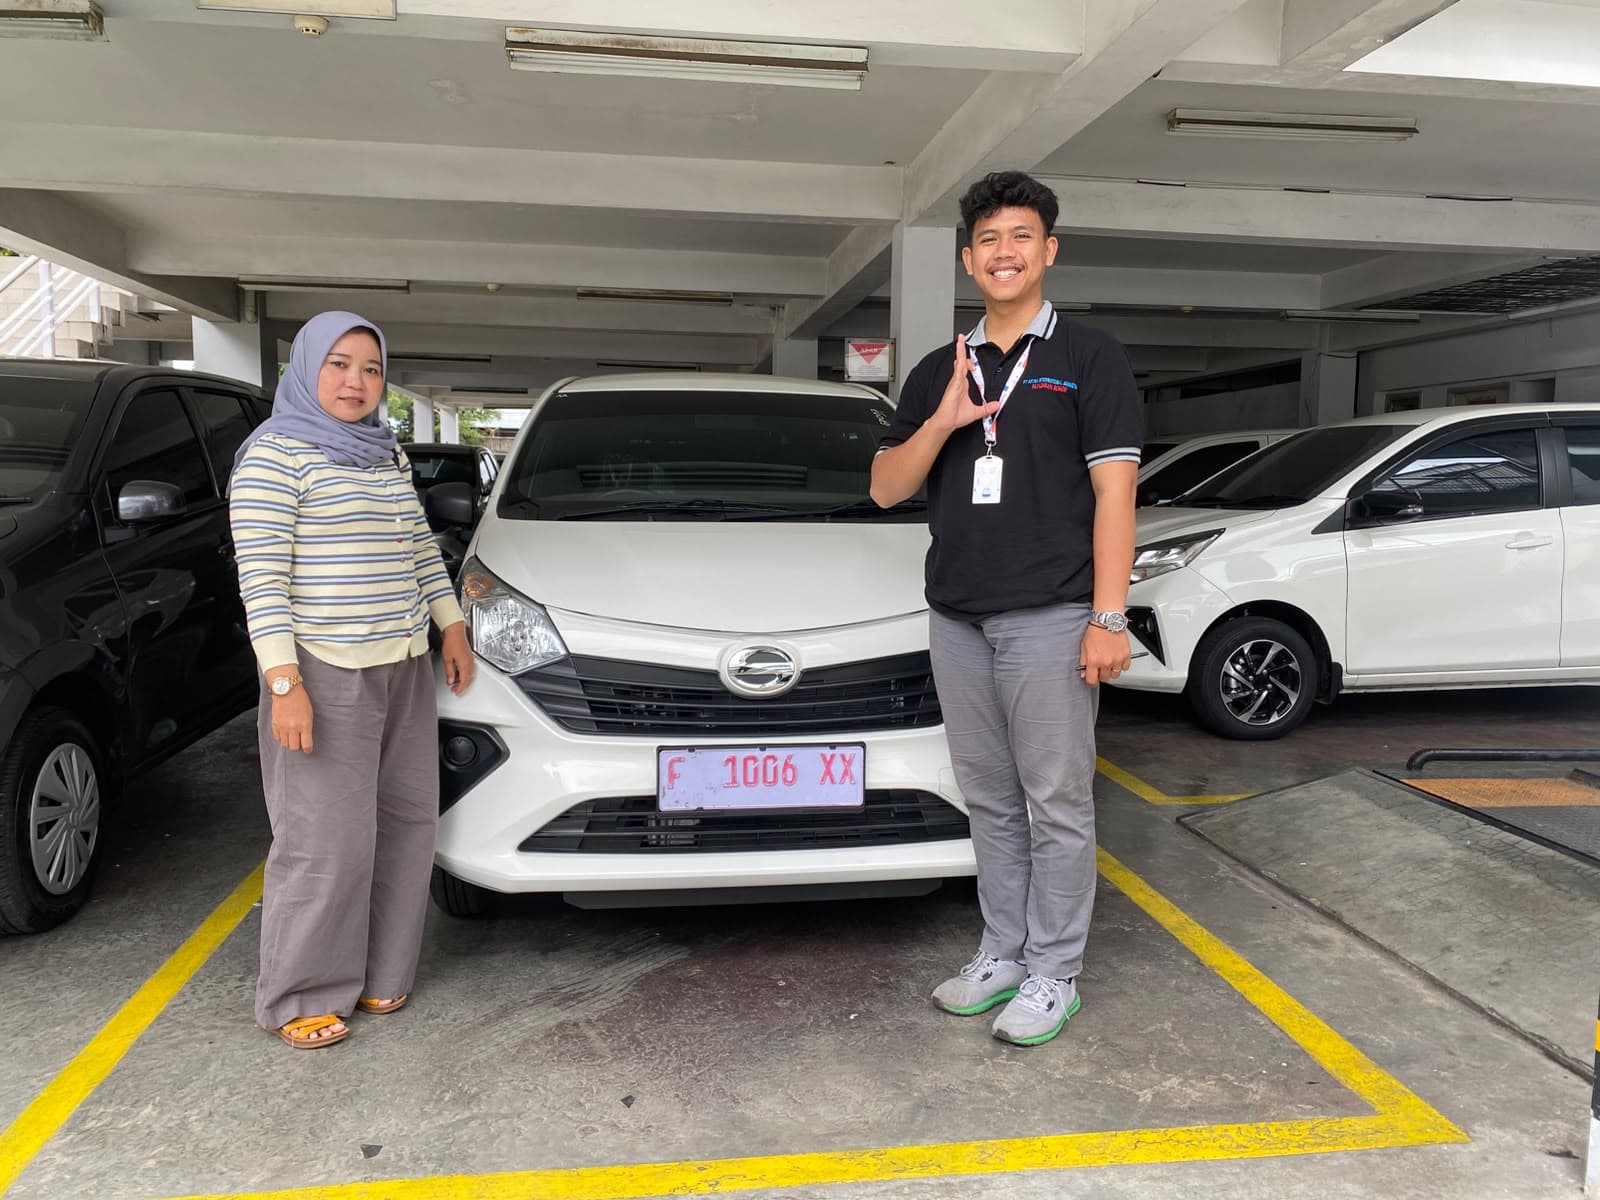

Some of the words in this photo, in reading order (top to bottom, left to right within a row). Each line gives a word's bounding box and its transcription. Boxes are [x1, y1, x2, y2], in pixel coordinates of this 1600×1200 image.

[667, 756, 685, 790] F
[722, 754, 798, 788] 1006
[819, 752, 856, 785] XX
